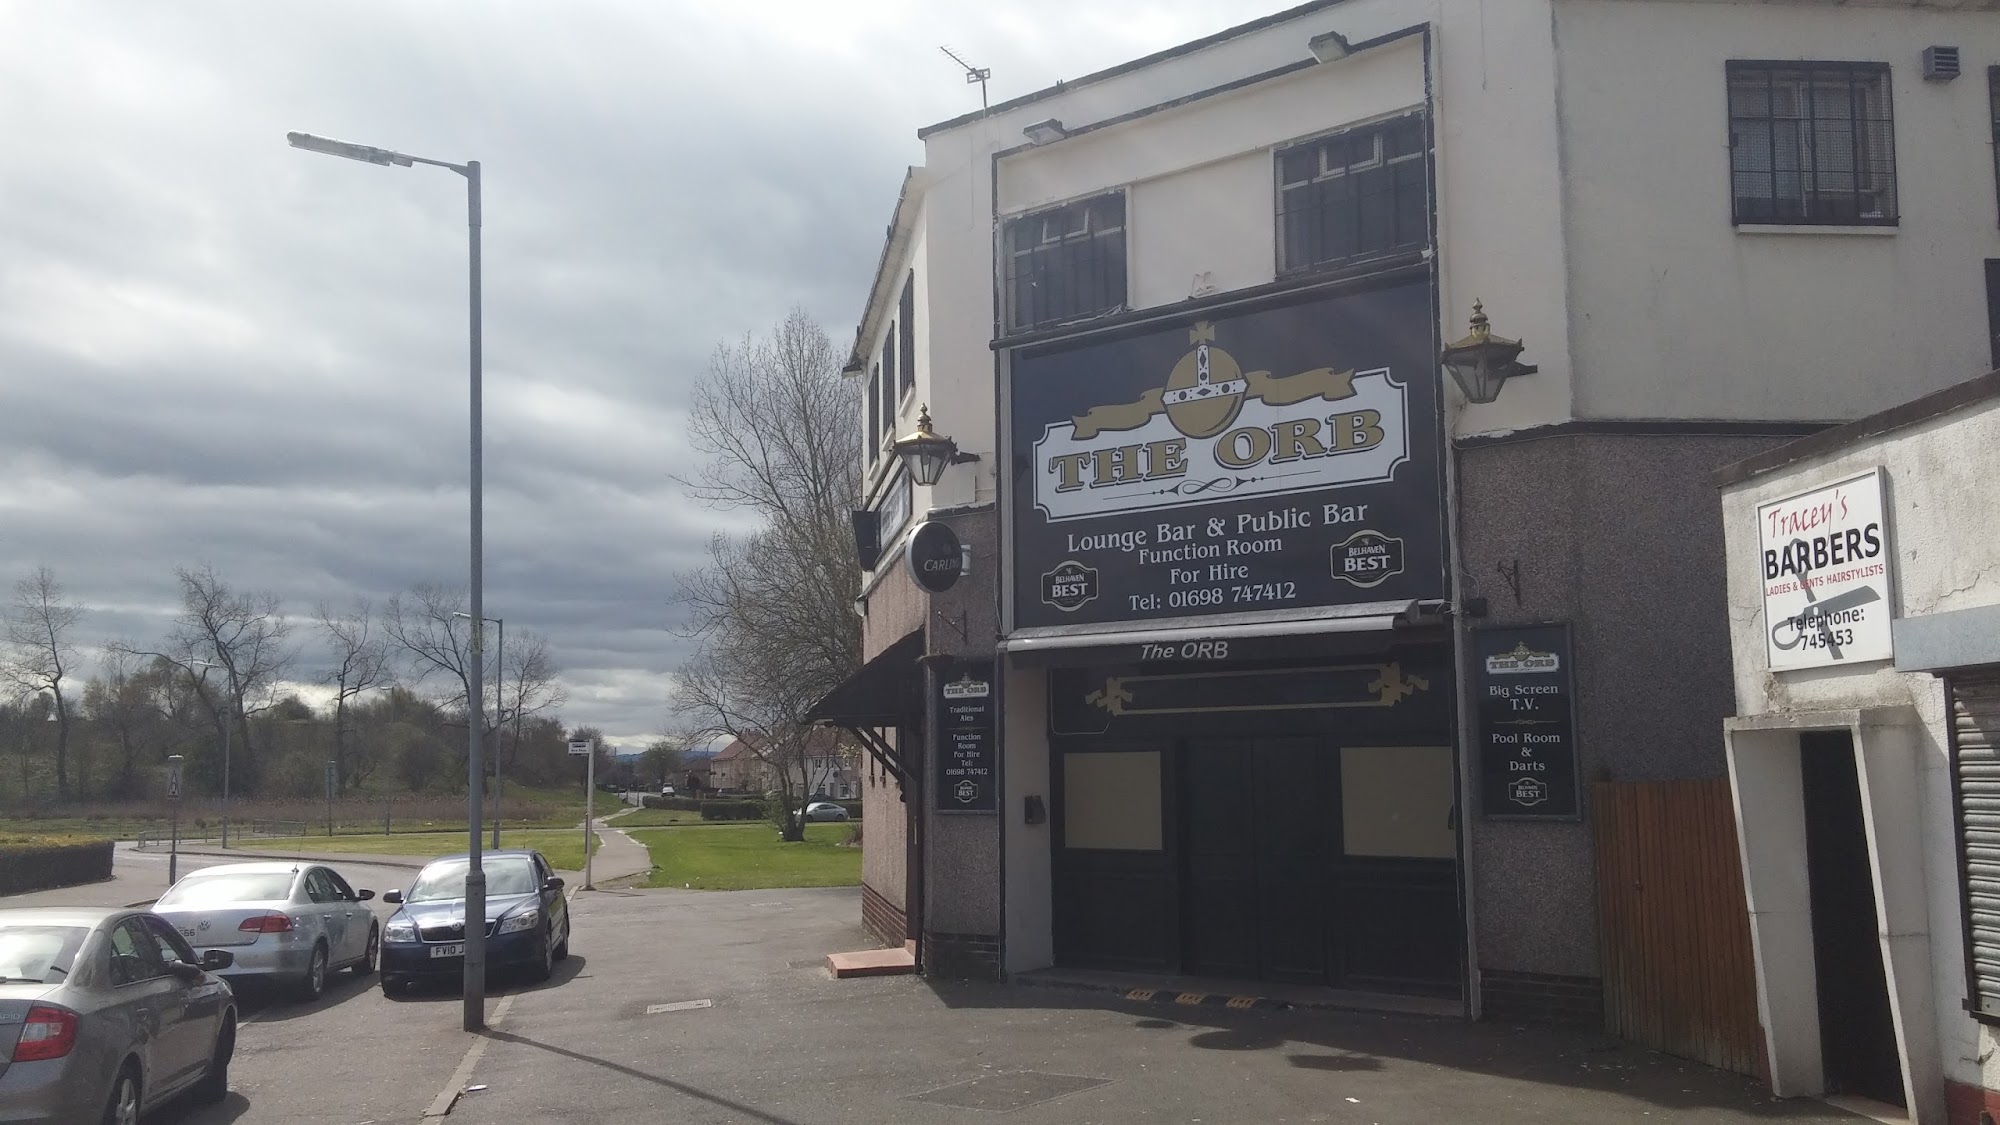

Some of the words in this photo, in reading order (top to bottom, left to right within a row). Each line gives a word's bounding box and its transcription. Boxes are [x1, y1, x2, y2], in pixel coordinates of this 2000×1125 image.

[1048, 437, 1189, 493] THE
[1212, 409, 1386, 469] ORB
[1768, 489, 1849, 546] Tracey's
[1067, 526, 1147, 552] Lounge
[1156, 523, 1196, 543] Bar
[1206, 517, 1226, 537] &
[1237, 507, 1312, 534] Public
[1323, 503, 1368, 525] Bar
[1138, 542, 1220, 565] Function
[1226, 538, 1283, 556] Room
[1348, 544, 1386, 557] BELHAVEN
[1764, 522, 1881, 580] BARBERS
[924, 557, 960, 571] CARLI
[1343, 554, 1392, 572] BEST
[1055, 573, 1085, 585] BELHAVEN
[1170, 567, 1201, 585] For
[1209, 563, 1249, 580] Hire
[1766, 581, 1792, 597] LADIES
[1792, 581, 1799, 592] &
[1800, 576, 1824, 590] GENTS
[1826, 563, 1884, 585] HAIRSTYLISTS
[1051, 582, 1089, 598] BEST
[1129, 594, 1162, 611] Tel:
[1168, 587, 1224, 608] 01698
[1231, 582, 1297, 604] 747412
[1787, 607, 1865, 632] Telephone:
[1800, 628, 1854, 651] 745453
[1139, 643, 1175, 661] The
[1180, 641, 1229, 660] ORB
[1489, 660, 1519, 670] THE
[1522, 658, 1555, 669] ORB
[946, 687, 964, 695] THE
[967, 686, 987, 694] ORB
[1489, 685, 1510, 698] Big
[1515, 684, 1559, 696] Screen
[950, 705, 985, 714] Traditional
[1510, 698, 1539, 711] T.V.
[960, 714, 974, 722] Ales
[953, 733, 981, 741] Function
[1492, 733, 1518, 744] Pool
[1524, 732, 1560, 743] Room
[957, 742, 976, 750] Room
[1521, 747, 1532, 757] &
[961, 759, 974, 767] Tel:
[1509, 760, 1546, 772] Darts
[946, 768, 965, 776] 01698
[967, 767, 988, 775] 747412
[1515, 790, 1541, 798] BEST
[435, 945, 456, 956] FV10
